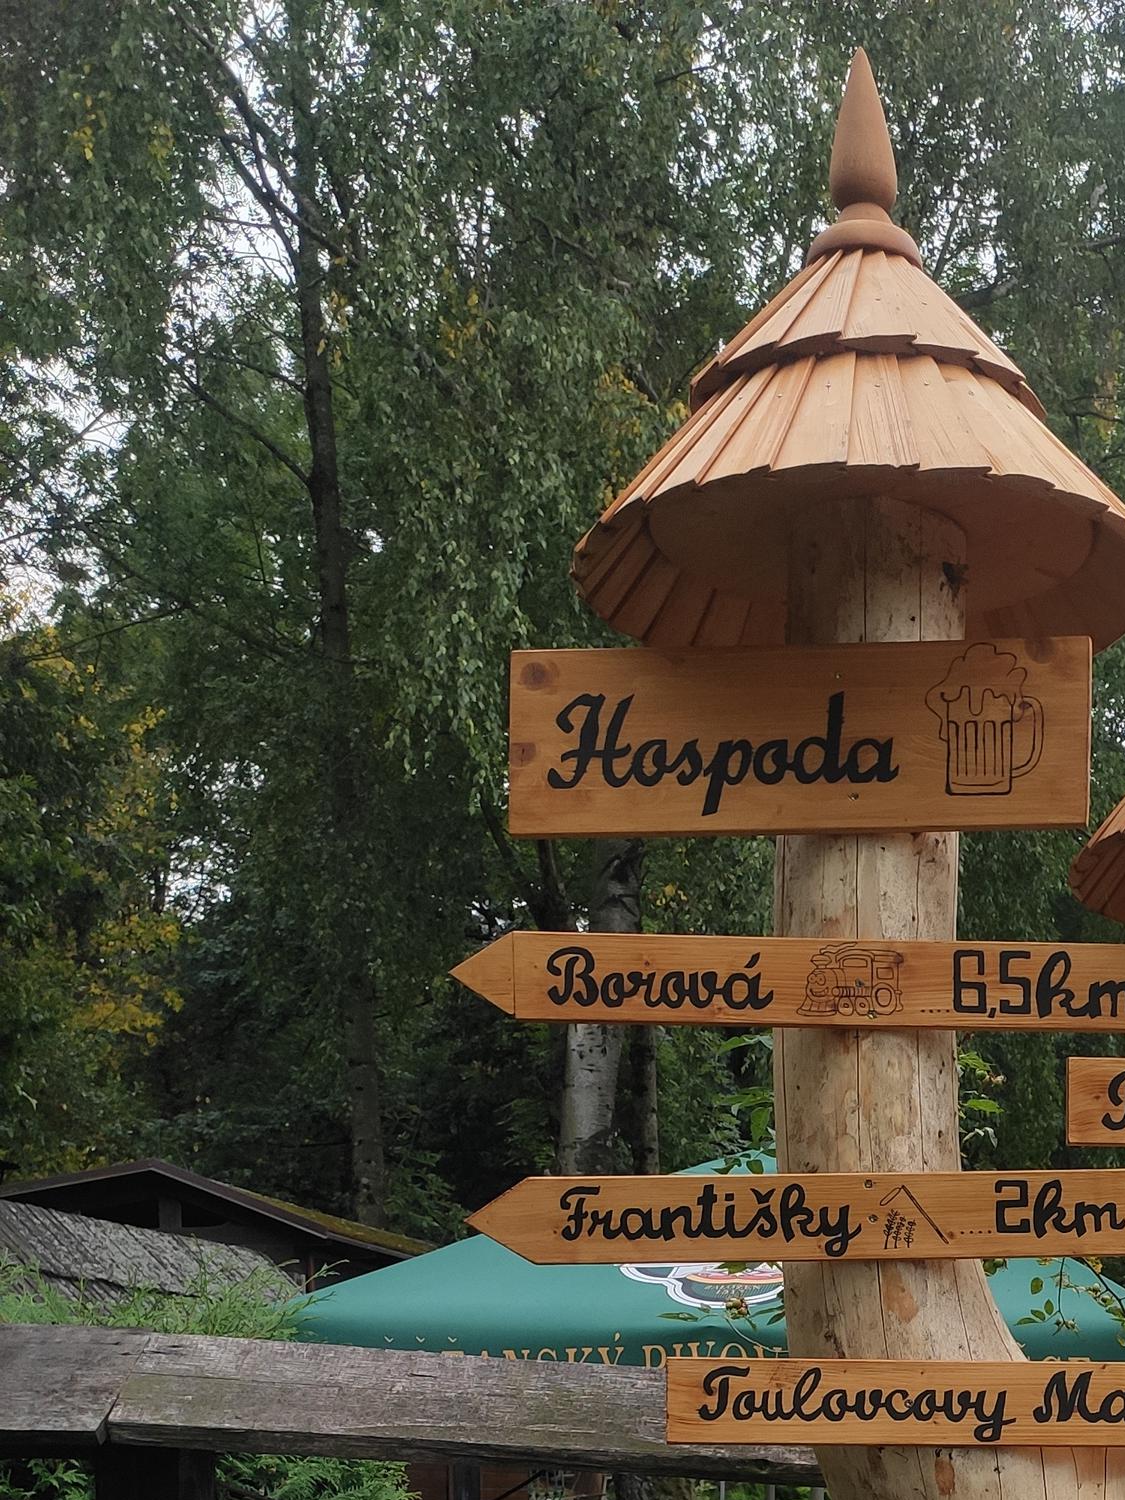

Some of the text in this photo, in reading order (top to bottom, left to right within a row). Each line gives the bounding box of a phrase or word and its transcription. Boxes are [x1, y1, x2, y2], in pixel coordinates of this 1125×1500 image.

[547, 690, 899, 816] Hospoda
[547, 946, 774, 1010] Borová
[560, 1183, 862, 1257] Františky
[696, 1366, 1017, 1442] Toulovcovy
